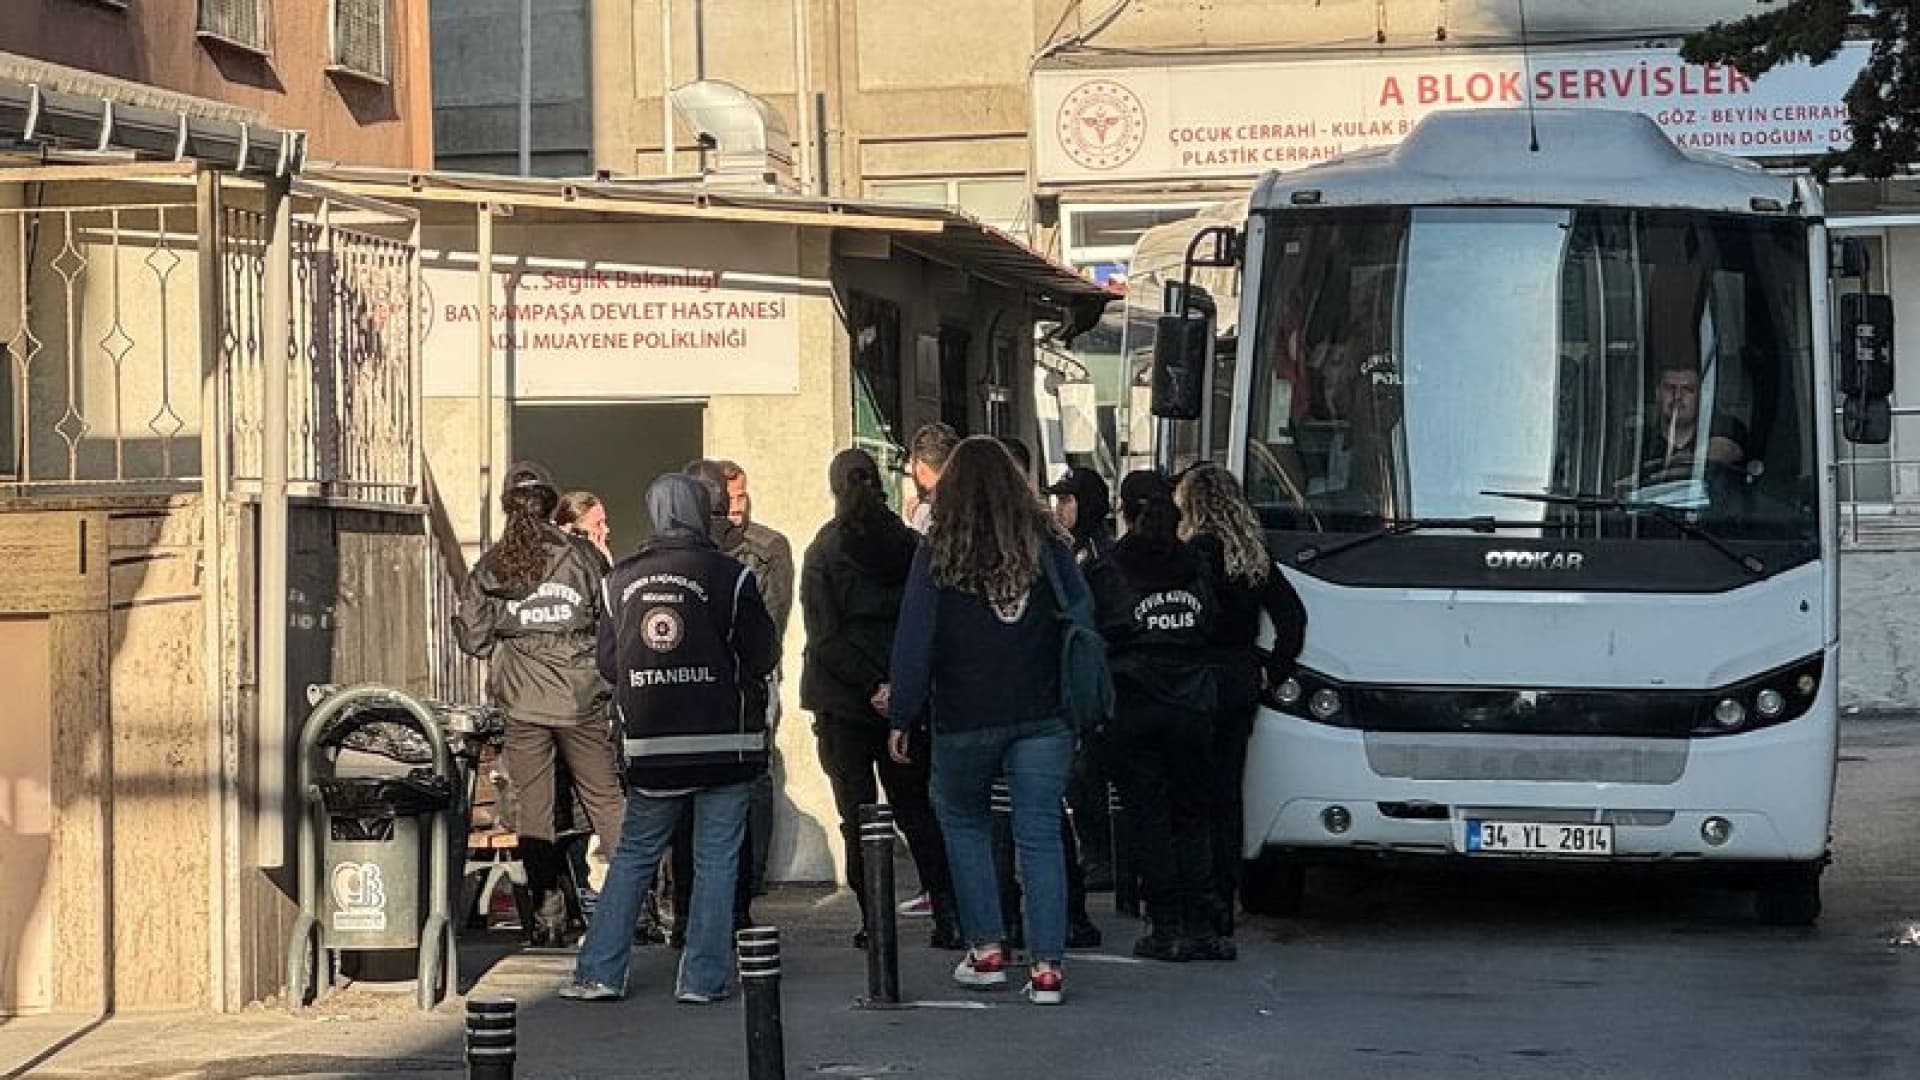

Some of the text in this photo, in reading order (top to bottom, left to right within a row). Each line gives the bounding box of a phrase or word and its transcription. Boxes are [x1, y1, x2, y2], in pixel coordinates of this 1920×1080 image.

[1379, 61, 1751, 106] A BLOK SERVİSLER
[1658, 107, 1696, 125] GÖZ
[1711, 106, 1767, 123] BEYİN
[1773, 105, 1847, 121] CERRAH
[1168, 126, 1232, 146] ÇOCUK
[1237, 121, 1316, 140] CERRAHİ
[1332, 120, 1393, 137] KULAK
[1677, 131, 1735, 147] KADIN
[1741, 128, 1812, 145] DOĞUM
[1182, 147, 1258, 166] PLASTİK
[542, 269, 608, 294] Sağlık
[591, 302, 667, 320] DEVLET
[671, 297, 786, 320] HASTANESİ
[533, 332, 628, 349] MUAYENE
[633, 327, 748, 349] POLİKLİNİĞİ
[1485, 551, 1584, 569] OTOKAR
[1483, 825, 1606, 850] 34 YL 2814
